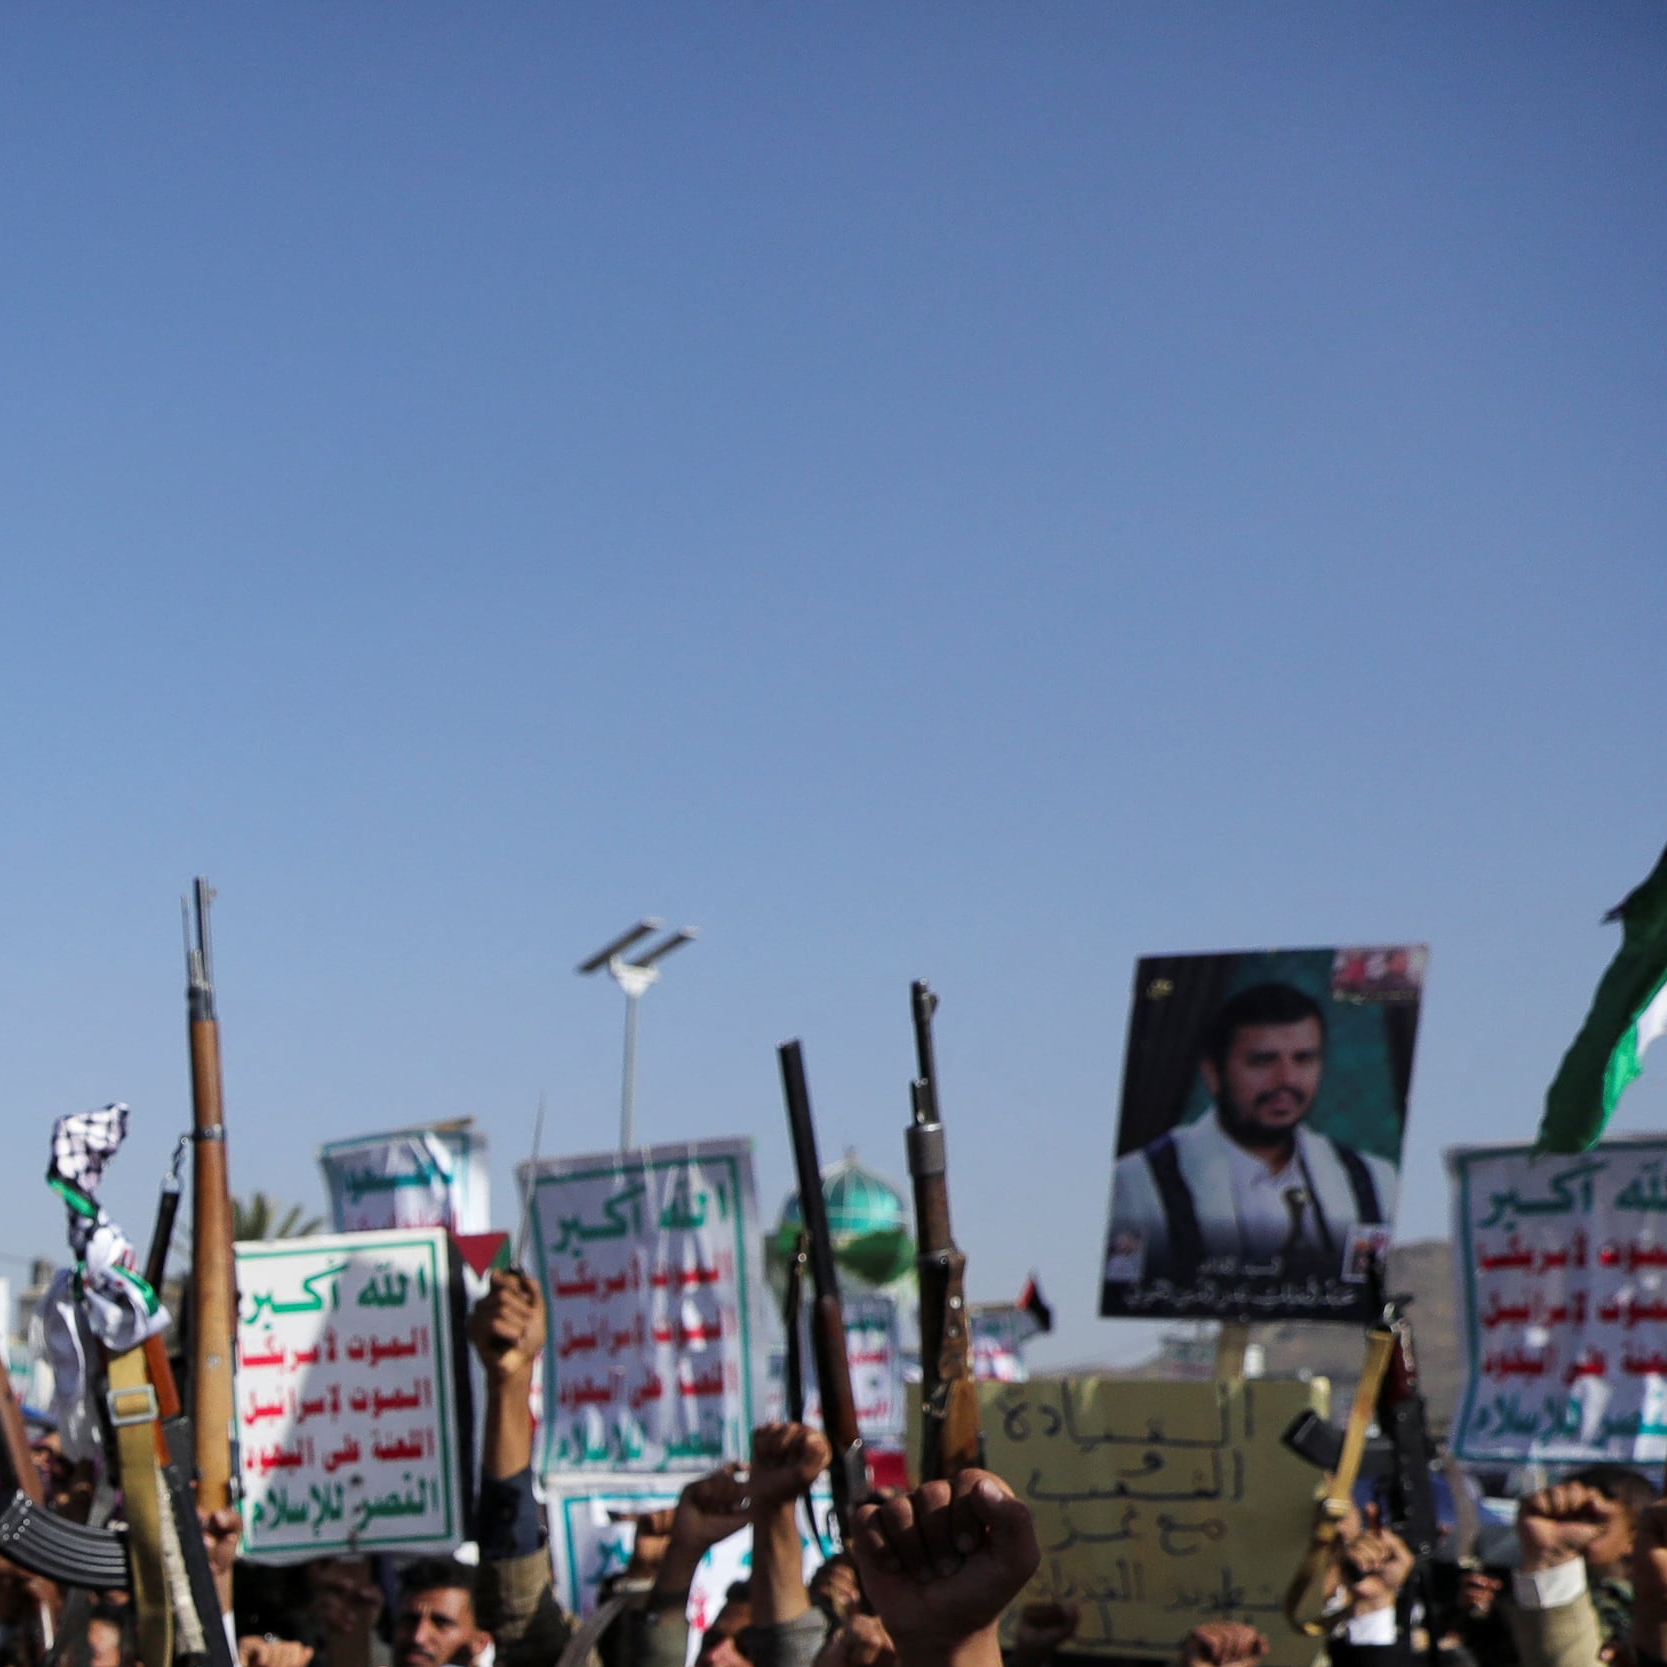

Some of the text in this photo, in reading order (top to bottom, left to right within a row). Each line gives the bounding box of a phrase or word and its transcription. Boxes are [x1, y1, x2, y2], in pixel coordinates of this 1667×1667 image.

[550, 1178, 647, 1259] أكبر
[243, 1257, 427, 1331] الله أكبر
[346, 1326, 429, 1369] الموت
[350, 1377, 433, 1419] الموت
[373, 1426, 436, 1461] اللعنة
[251, 1472, 440, 1536] النصر للإسلام
